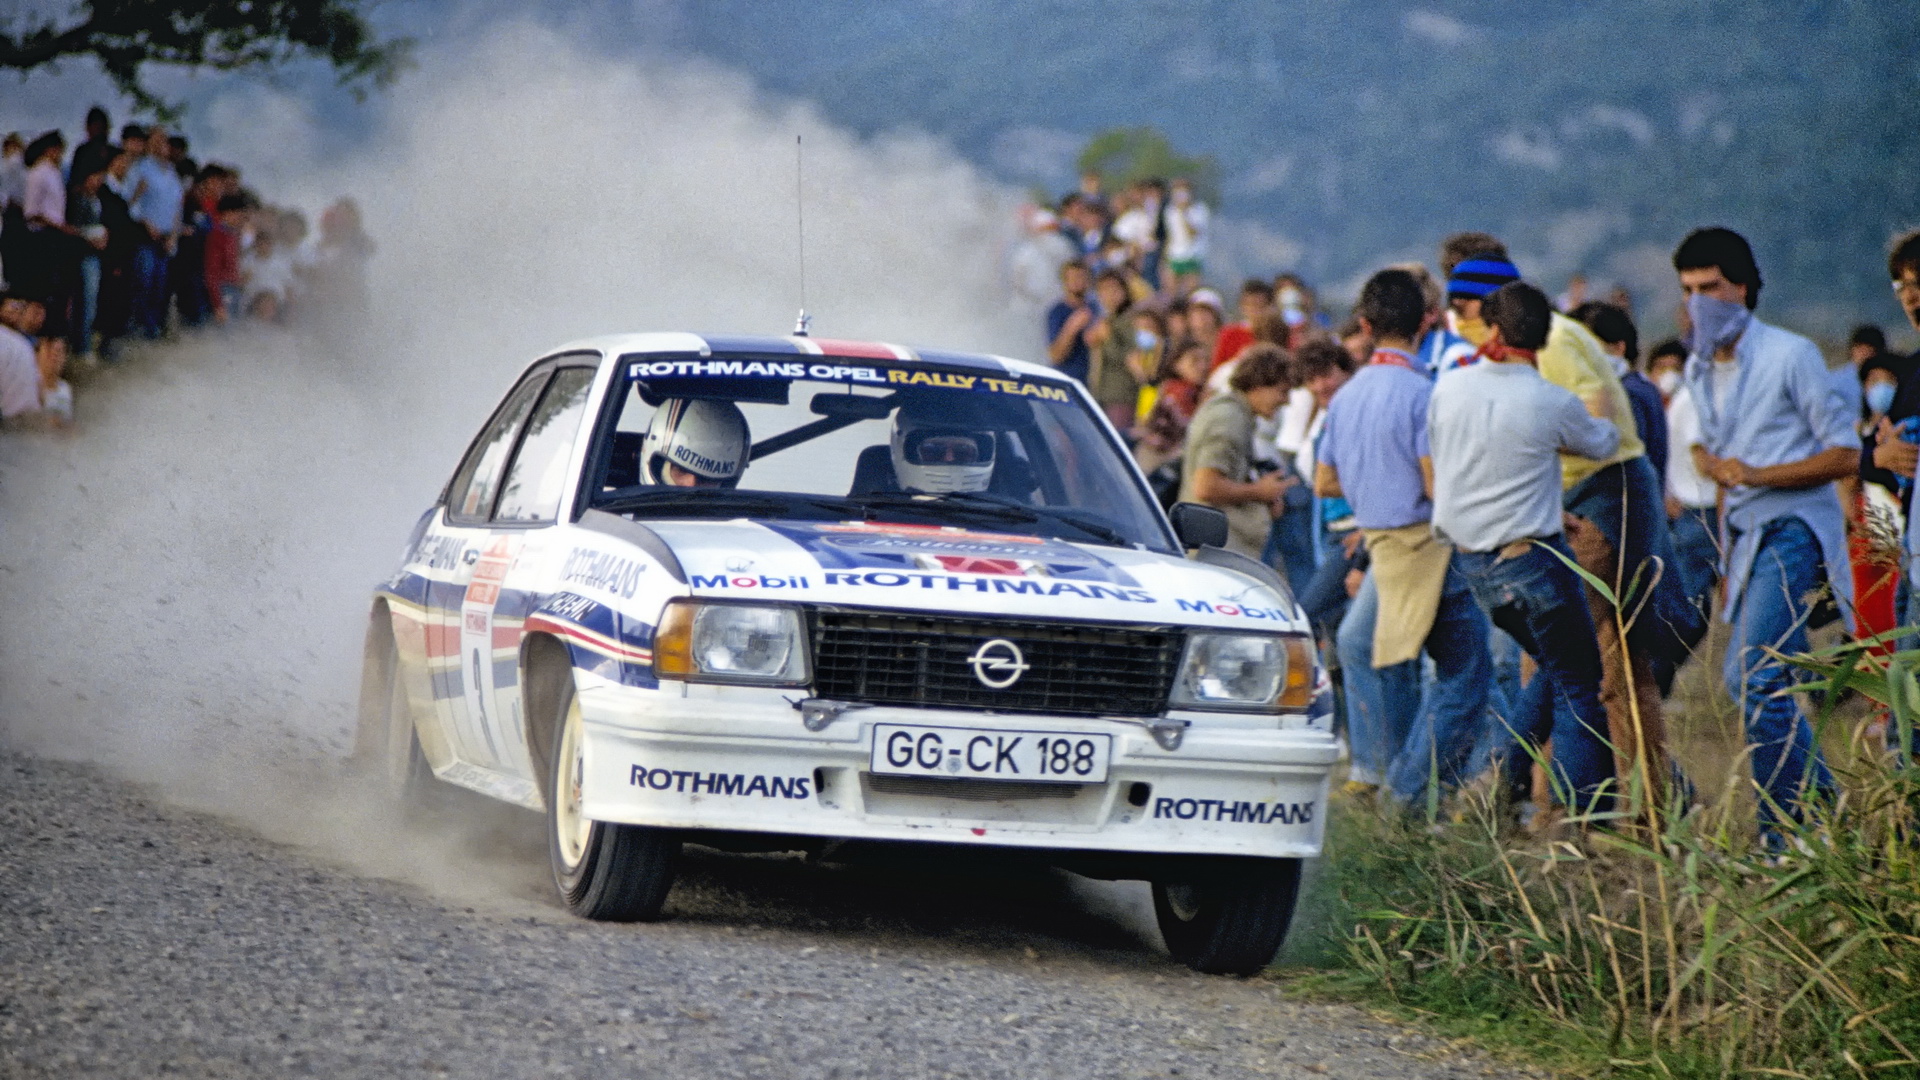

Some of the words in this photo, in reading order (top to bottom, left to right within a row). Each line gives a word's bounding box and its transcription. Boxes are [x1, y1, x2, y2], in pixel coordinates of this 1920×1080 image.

[629, 361, 806, 378] ROTHMANS
[808, 366, 885, 381] OPEL
[888, 371, 976, 388] RALLY
[984, 378, 1069, 402] TEAM
[674, 445, 735, 474] ROTHMANS
[559, 546, 648, 600] ROTHMANS
[692, 575, 809, 589] Mobil
[825, 573, 1156, 603] ROTHMANS
[1176, 600, 1290, 621] Mobil
[887, 731, 1023, 774] GG-CK
[1037, 738, 1094, 775] 188
[630, 764, 810, 799] ROTHMANS
[1154, 797, 1314, 825] ROTHMANS
